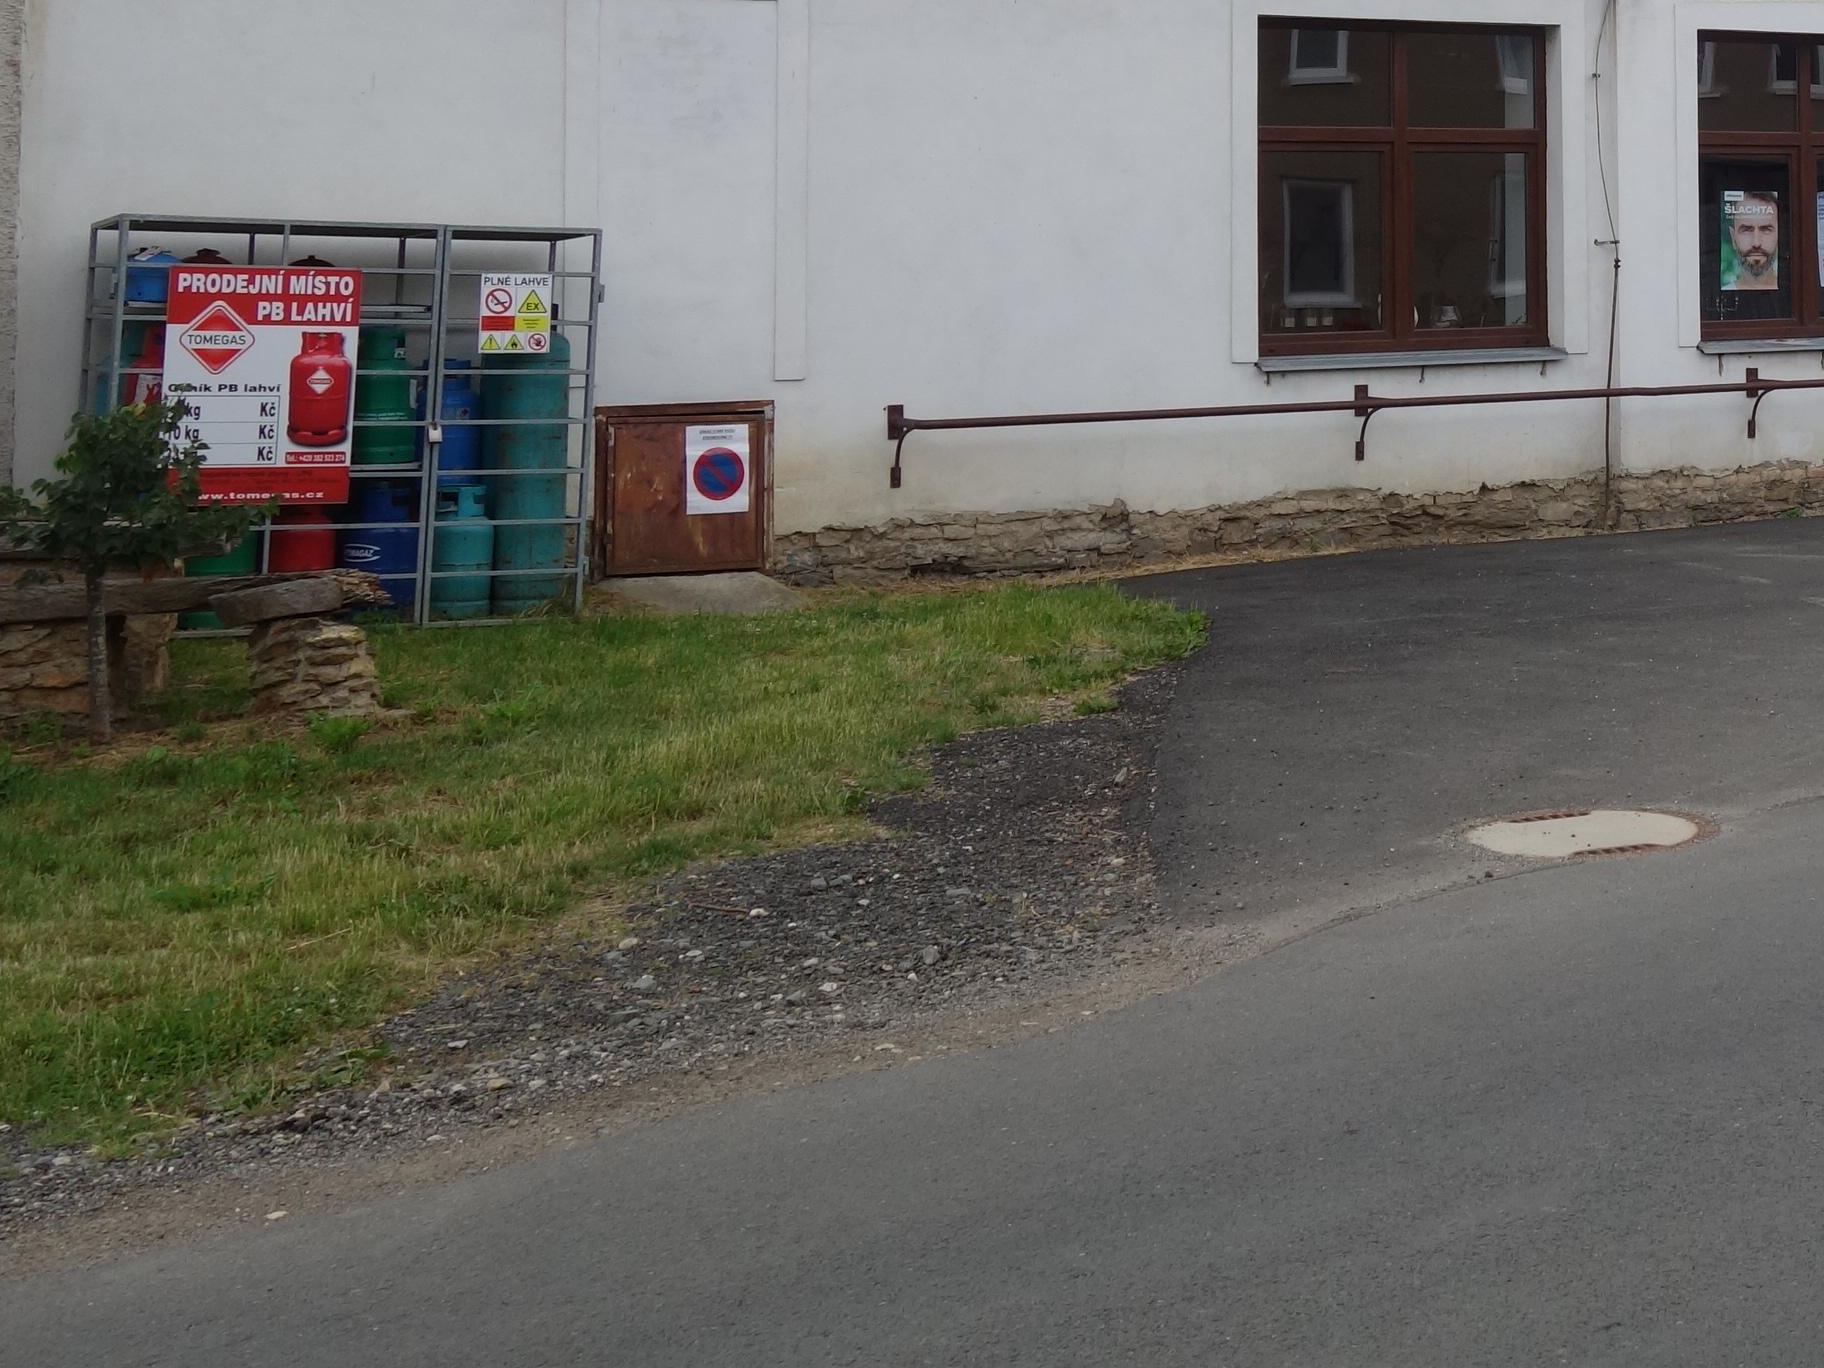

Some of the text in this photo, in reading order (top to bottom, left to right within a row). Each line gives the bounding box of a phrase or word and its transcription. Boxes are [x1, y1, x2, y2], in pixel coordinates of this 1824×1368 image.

[1724, 202, 1774, 214] ŠLACHTA
[177, 270, 354, 296] PRODEJNÍ MÍSTO
[484, 276, 549, 286] PLNÉ LAHVE
[257, 298, 354, 322] PB LAHVÍ
[526, 302, 540, 311] EX
[187, 333, 247, 346] TOMEGAS
[217, 384, 238, 393] PB
[244, 383, 282, 393] lahví
[260, 401, 277, 418] Kč
[258, 424, 275, 440] Kč
[256, 446, 274, 463] Kč
